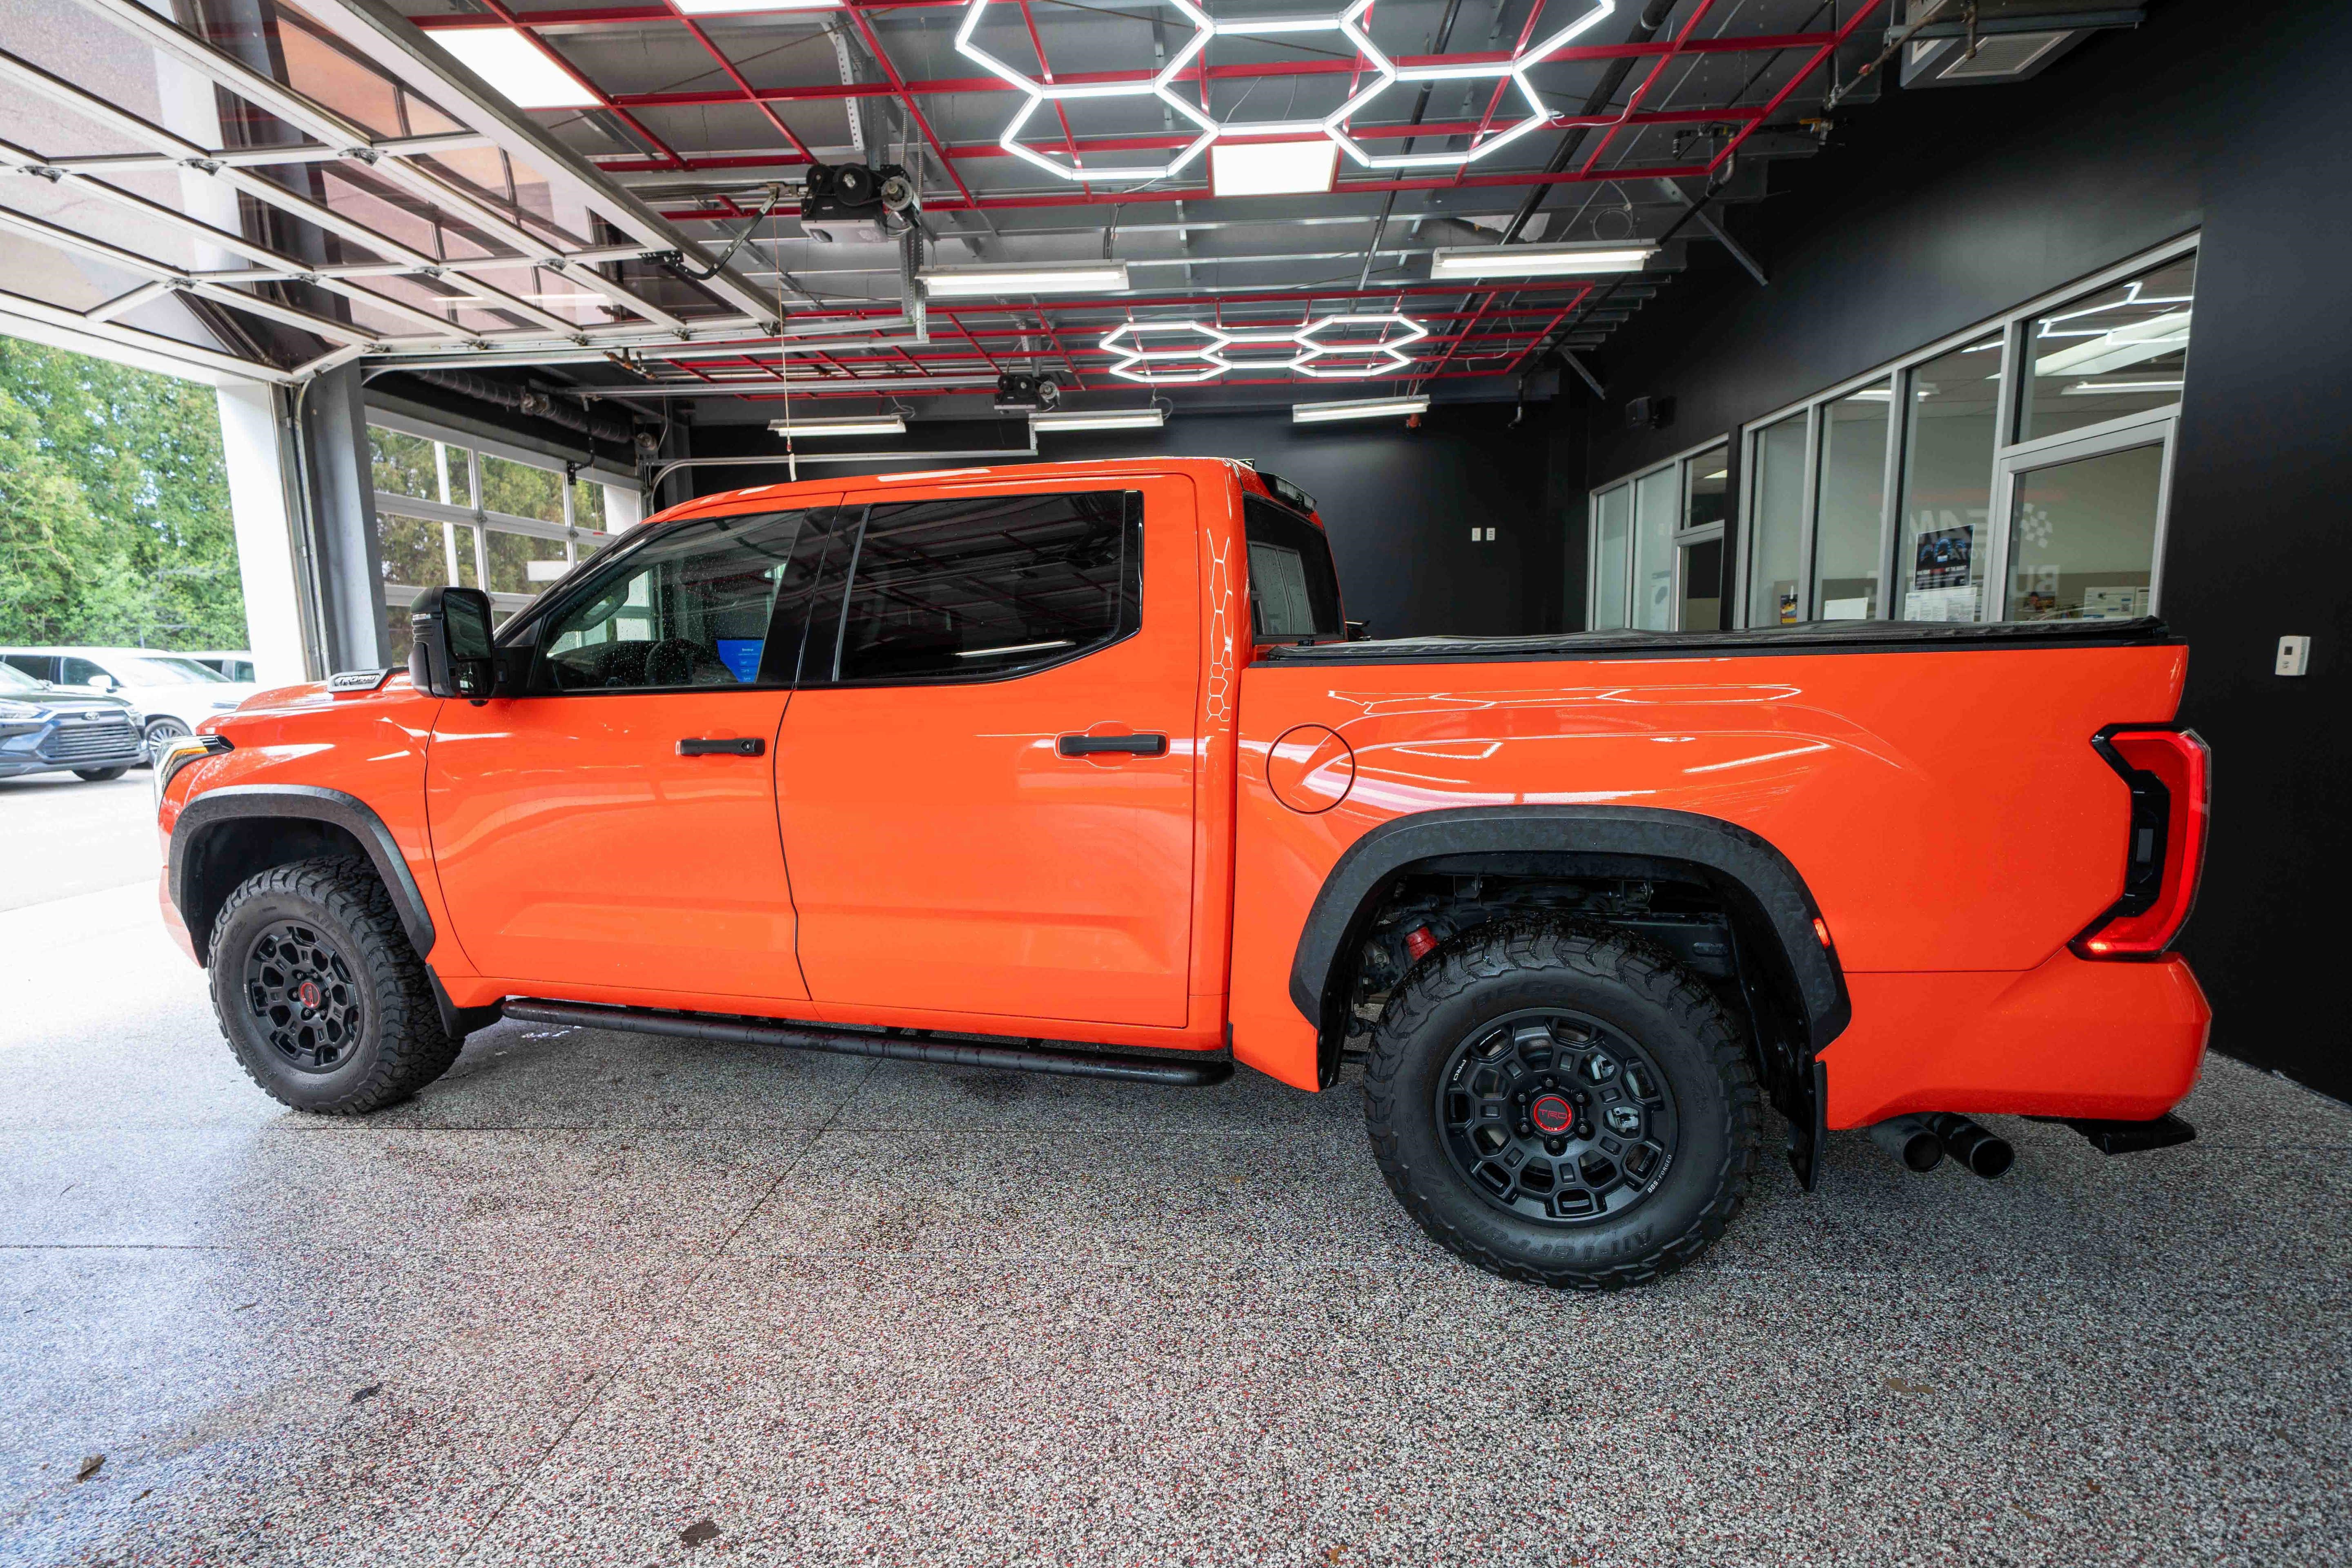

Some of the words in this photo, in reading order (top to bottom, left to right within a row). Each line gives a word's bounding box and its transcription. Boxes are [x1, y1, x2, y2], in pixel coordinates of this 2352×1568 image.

[335, 676, 359, 686] TRD
[1453, 1059, 1467, 1081] PRO
[1538, 1108, 1568, 1120] TRD
